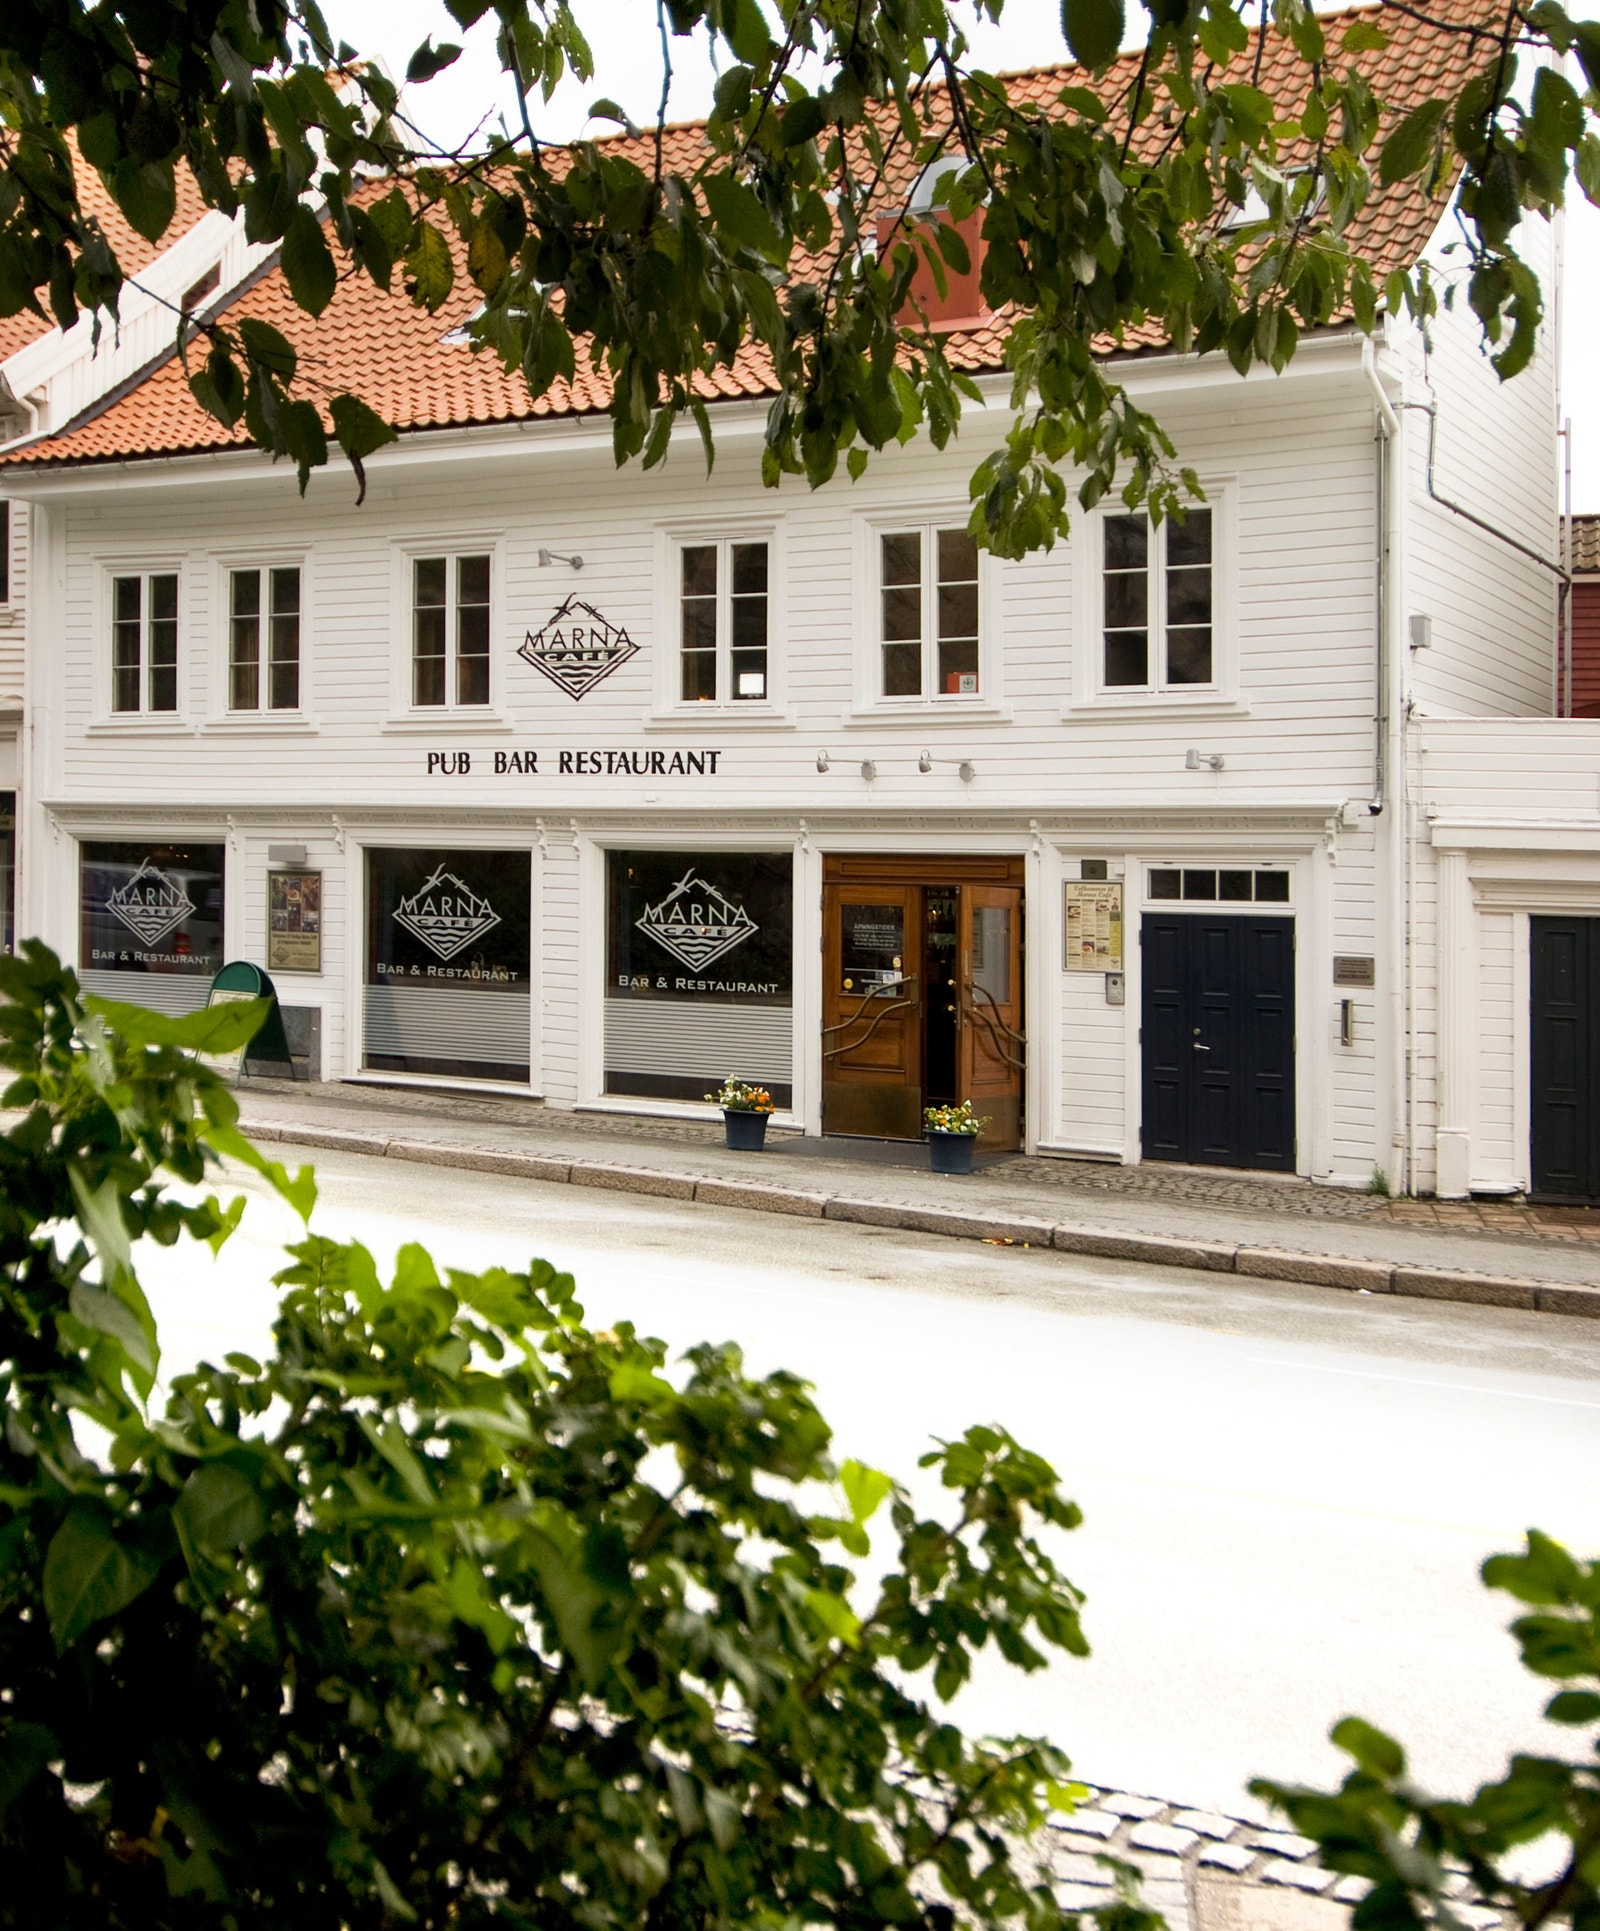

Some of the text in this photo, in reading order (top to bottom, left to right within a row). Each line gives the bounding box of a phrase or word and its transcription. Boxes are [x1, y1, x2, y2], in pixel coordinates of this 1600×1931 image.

[523, 627, 632, 650] MARNA
[543, 650, 609, 661] CAFÉ
[427, 751, 721, 775] PUB BAR RESTAURANT
[111, 887, 189, 907] MARNA
[125, 908, 174, 916] CAFÉ
[399, 895, 495, 917] MARNA
[643, 902, 751, 926] MARNA
[417, 918, 474, 928] CAFÉ
[120, 951, 129, 961] &
[410, 965, 420, 976] &
[656, 977, 668, 989] &
